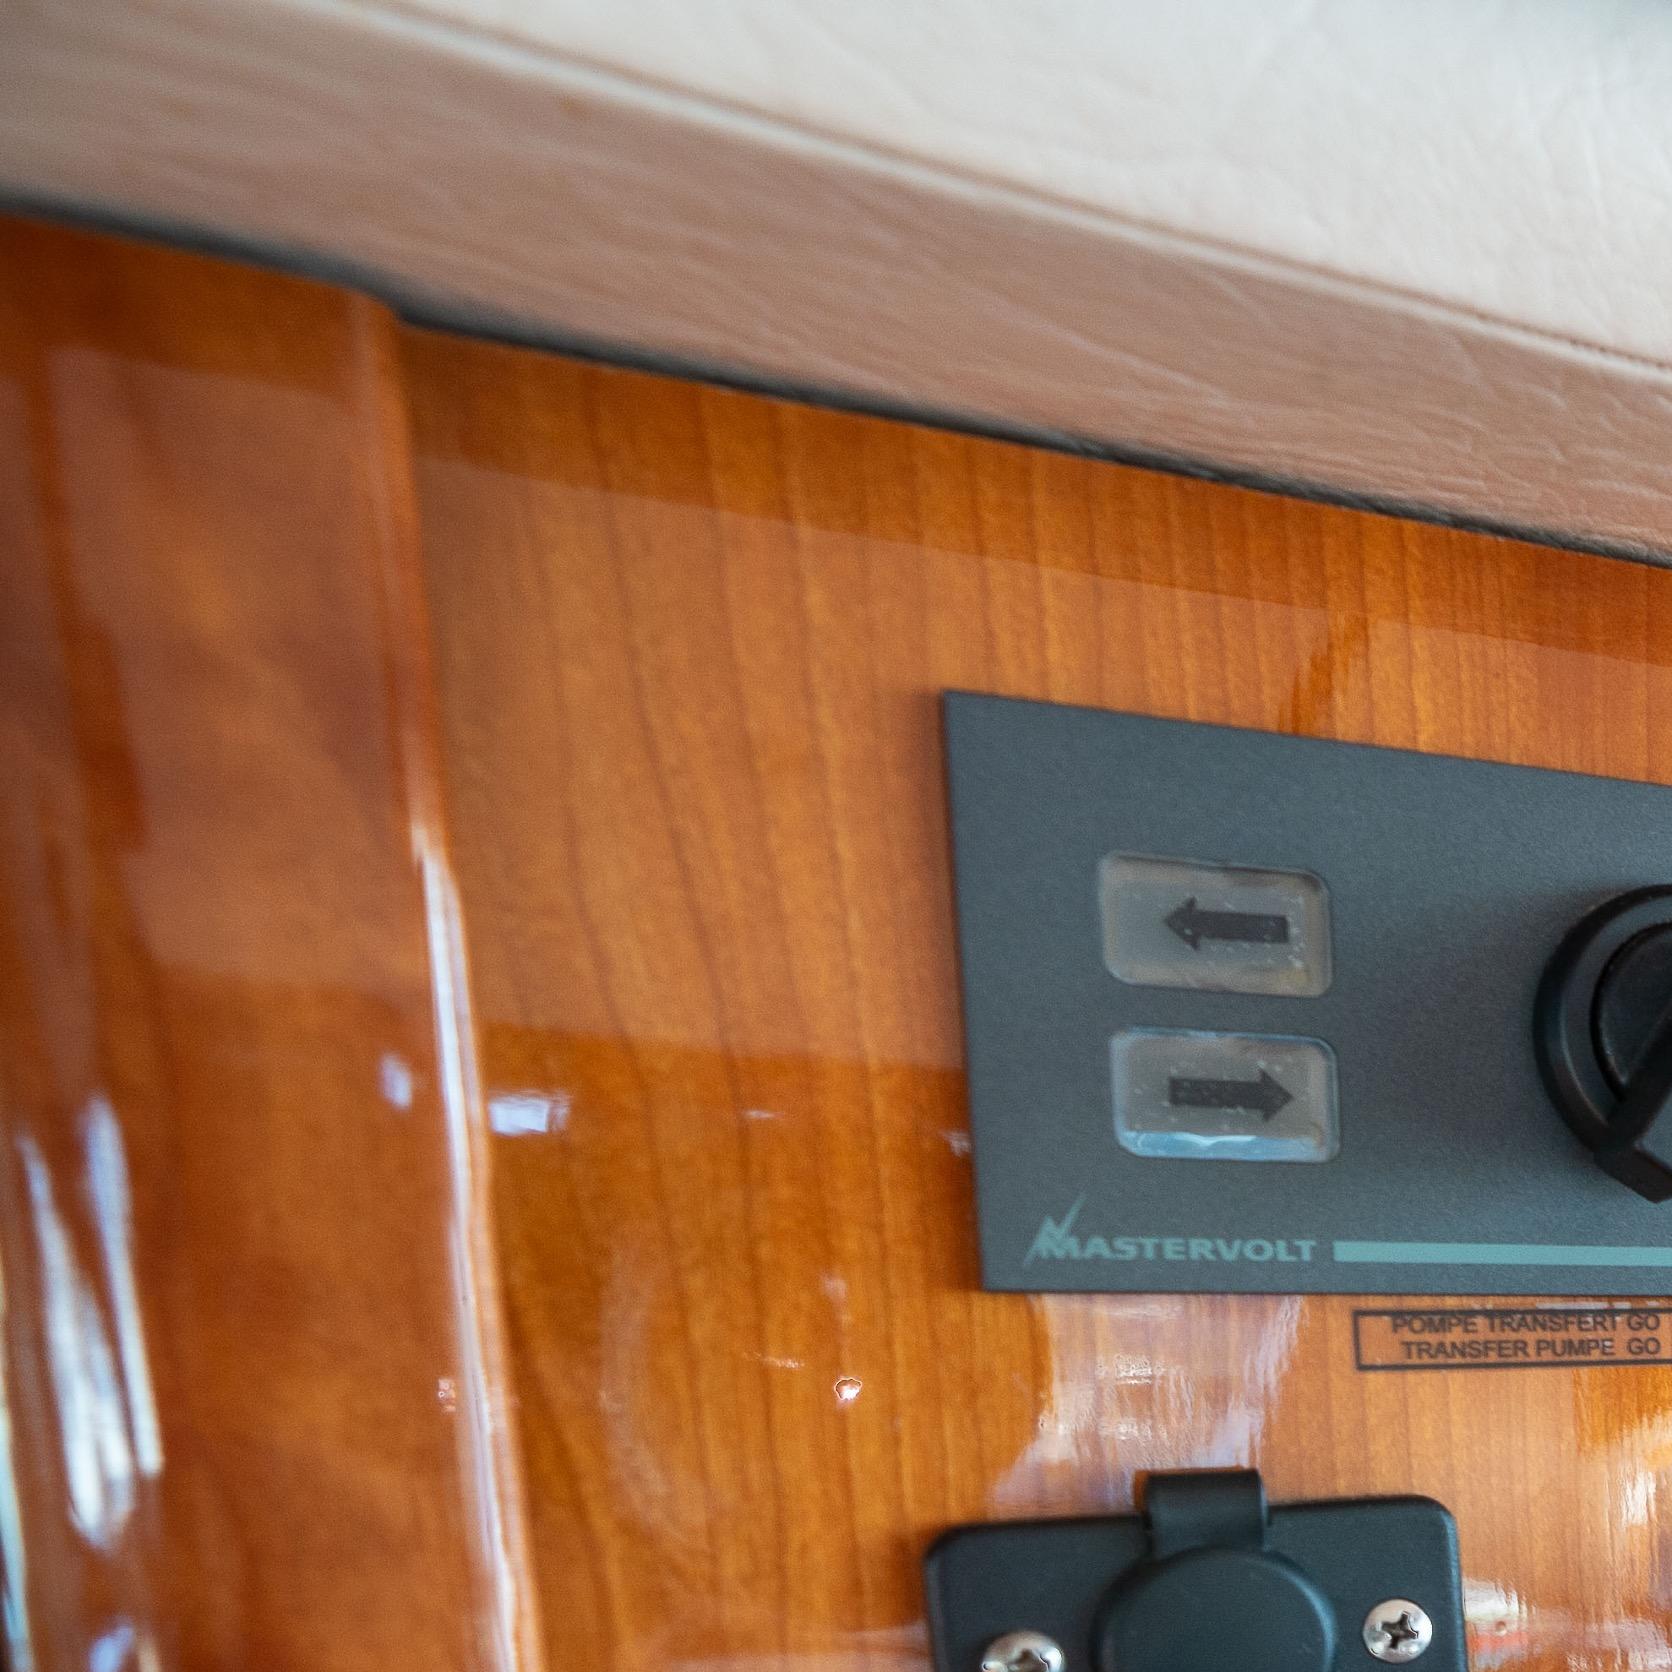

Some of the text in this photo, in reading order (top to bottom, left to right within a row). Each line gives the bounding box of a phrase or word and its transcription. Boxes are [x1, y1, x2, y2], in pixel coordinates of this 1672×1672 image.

[1392, 1312, 1661, 1334] POMPE TRANSFERT GO
[1402, 1337, 1661, 1360] TRANSFER PUMPE GO
